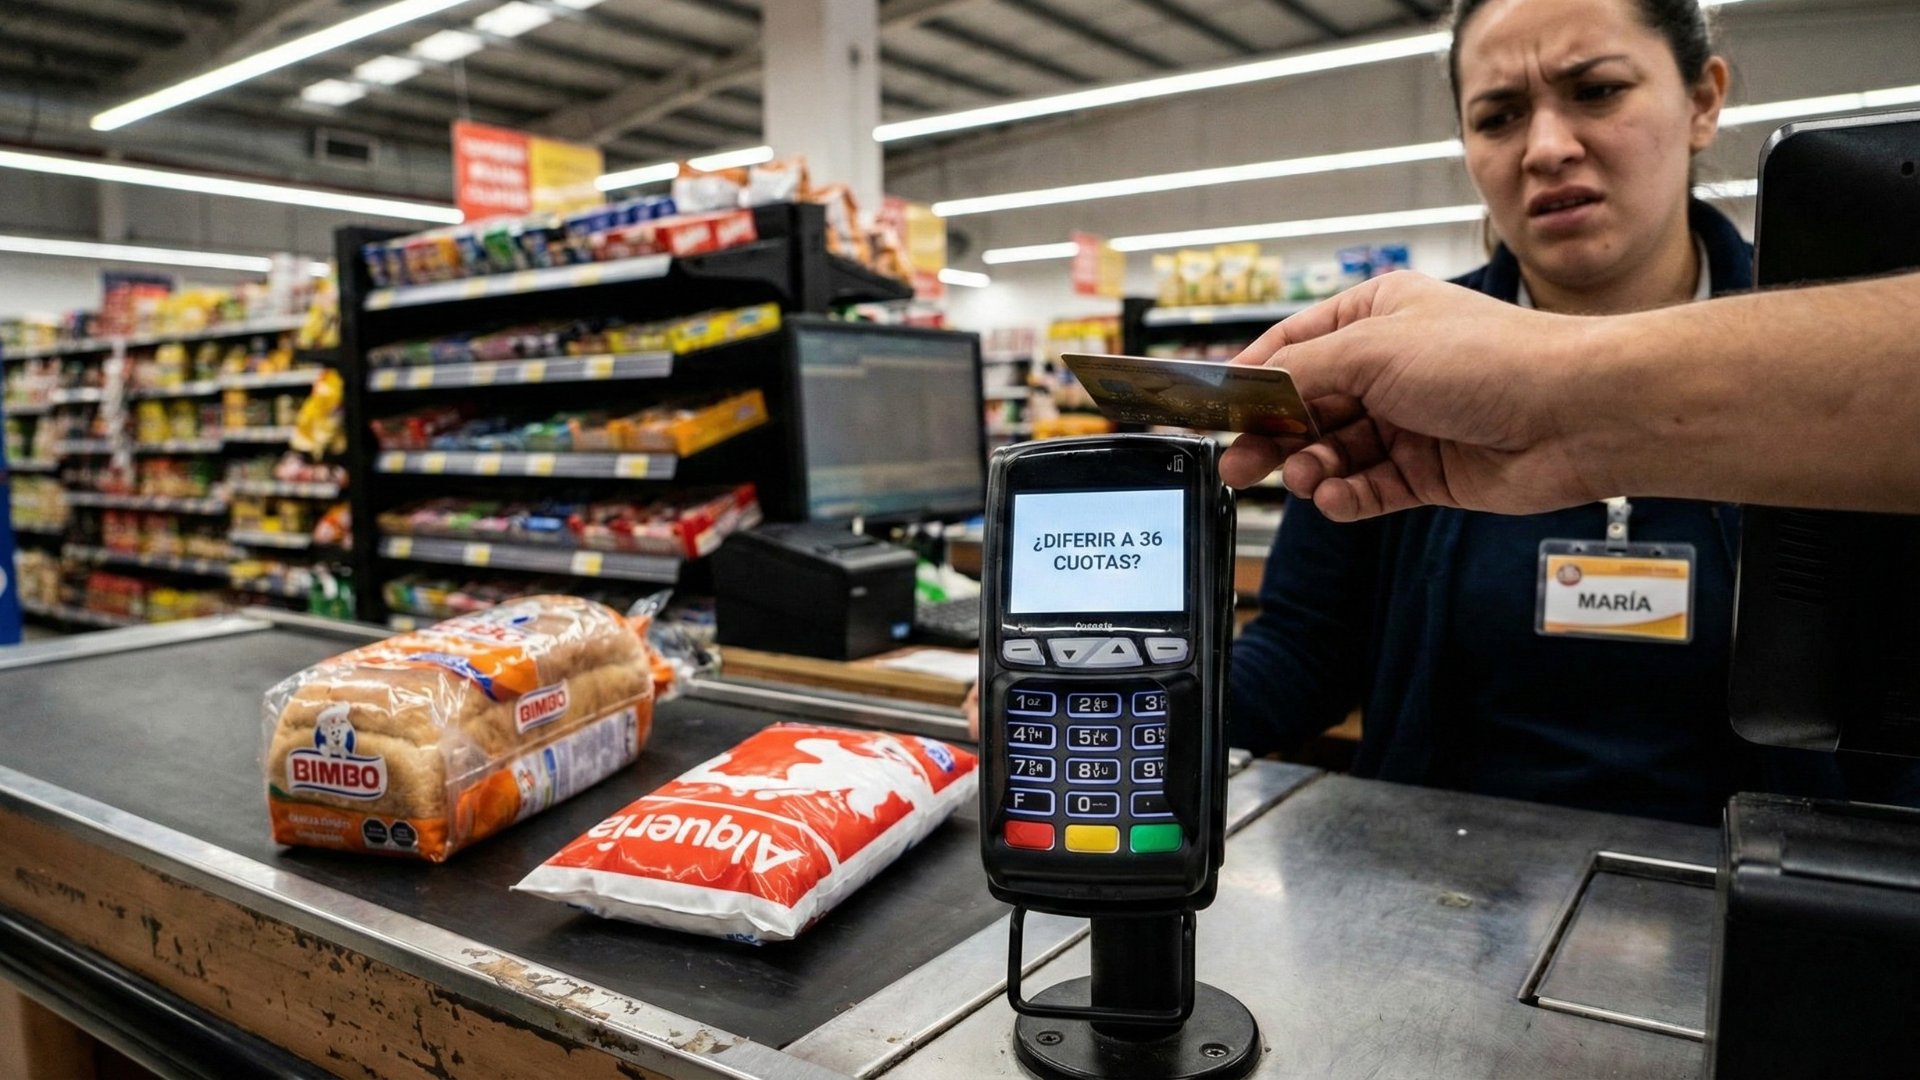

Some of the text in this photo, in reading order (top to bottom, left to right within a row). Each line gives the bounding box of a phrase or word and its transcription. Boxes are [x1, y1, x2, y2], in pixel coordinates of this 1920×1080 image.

[1033, 531, 1163, 552] ¿DIFERIR A 36
[1053, 554, 1141, 571] CUOTAS?
[1578, 591, 1652, 612] MARÍA
[520, 690, 567, 723] BIMBO
[1016, 694, 1025, 709] 1
[1079, 697, 1091, 712] 2
[1145, 695, 1157, 710] 3
[1013, 726, 1026, 741] 4
[1079, 730, 1091, 745] 5
[1144, 729, 1156, 744] 6
[293, 758, 380, 790] BIMBO
[1014, 759, 1026, 774] 7
[1079, 763, 1091, 778] 8
[1143, 762, 1156, 777] 9
[1014, 793, 1025, 809] F
[1078, 796, 1090, 812] 0
